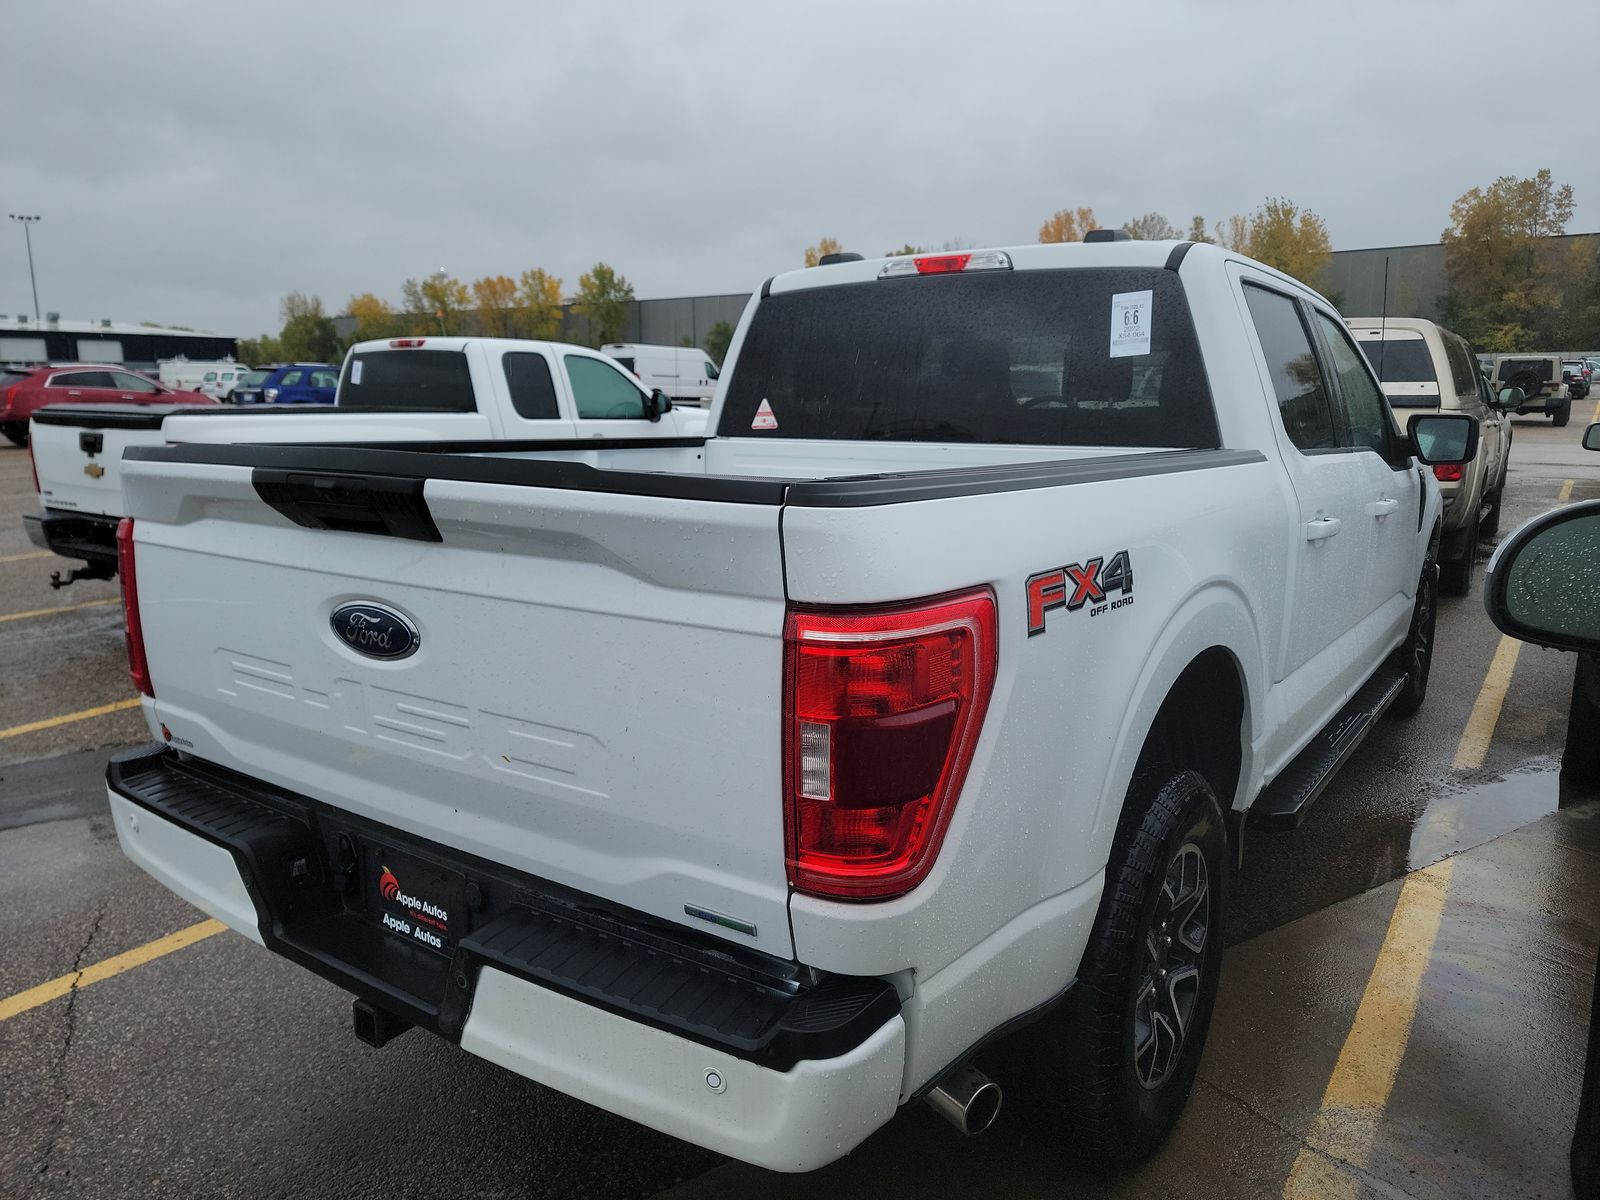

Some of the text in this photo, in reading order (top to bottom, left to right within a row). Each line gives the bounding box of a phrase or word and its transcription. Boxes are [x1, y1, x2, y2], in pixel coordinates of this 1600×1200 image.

[1025, 549, 1134, 639] FX4
[1090, 596, 1134, 617] OFF ROAD
[346, 612, 393, 648] Ford
[396, 890, 421, 910] Apple
[422, 901, 448, 921] Autos
[382, 913, 410, 934] Apple
[414, 927, 442, 948] Autos
